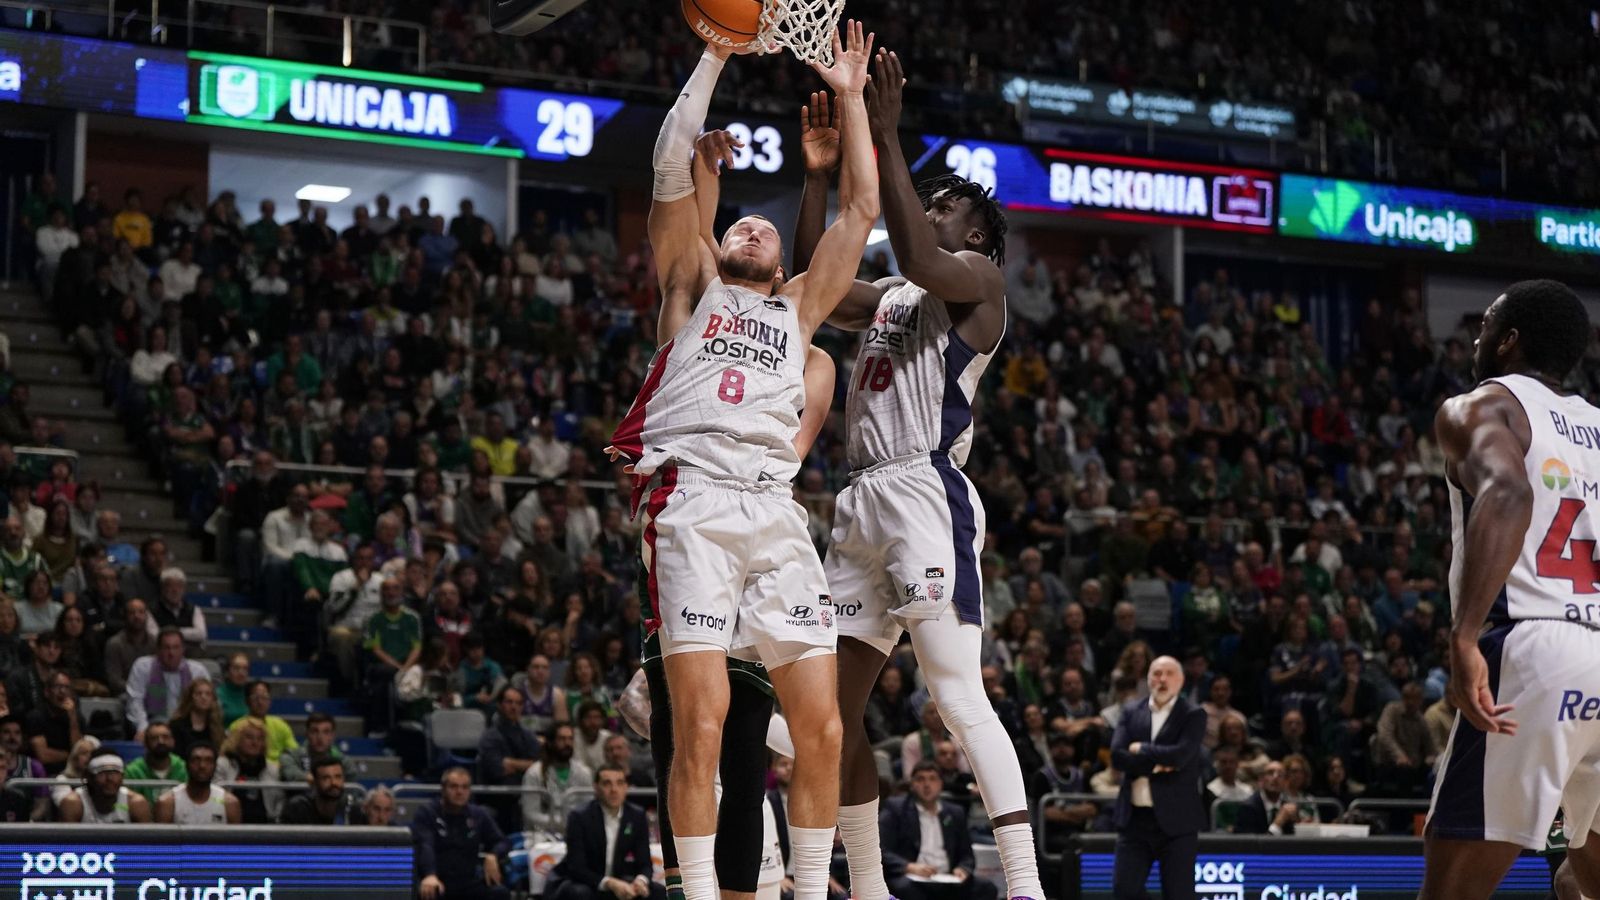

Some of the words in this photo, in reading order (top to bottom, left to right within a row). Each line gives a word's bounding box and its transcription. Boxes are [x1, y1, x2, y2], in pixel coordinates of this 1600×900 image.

[289, 78, 452, 137] UNICAJA
[536, 99, 594, 157] 29
[946, 144, 998, 199] 26
[1049, 162, 1208, 217] BASKONIA
[1365, 203, 1473, 252] Unicaja
[717, 368, 746, 405] 8
[859, 356, 893, 392] 18
[1536, 497, 1600, 594] 4
[785, 619, 819, 627] HYUNDAI
[1565, 603, 1600, 622] ar
[1557, 690, 1600, 722] Re
[138, 877, 273, 900] Ciudad
